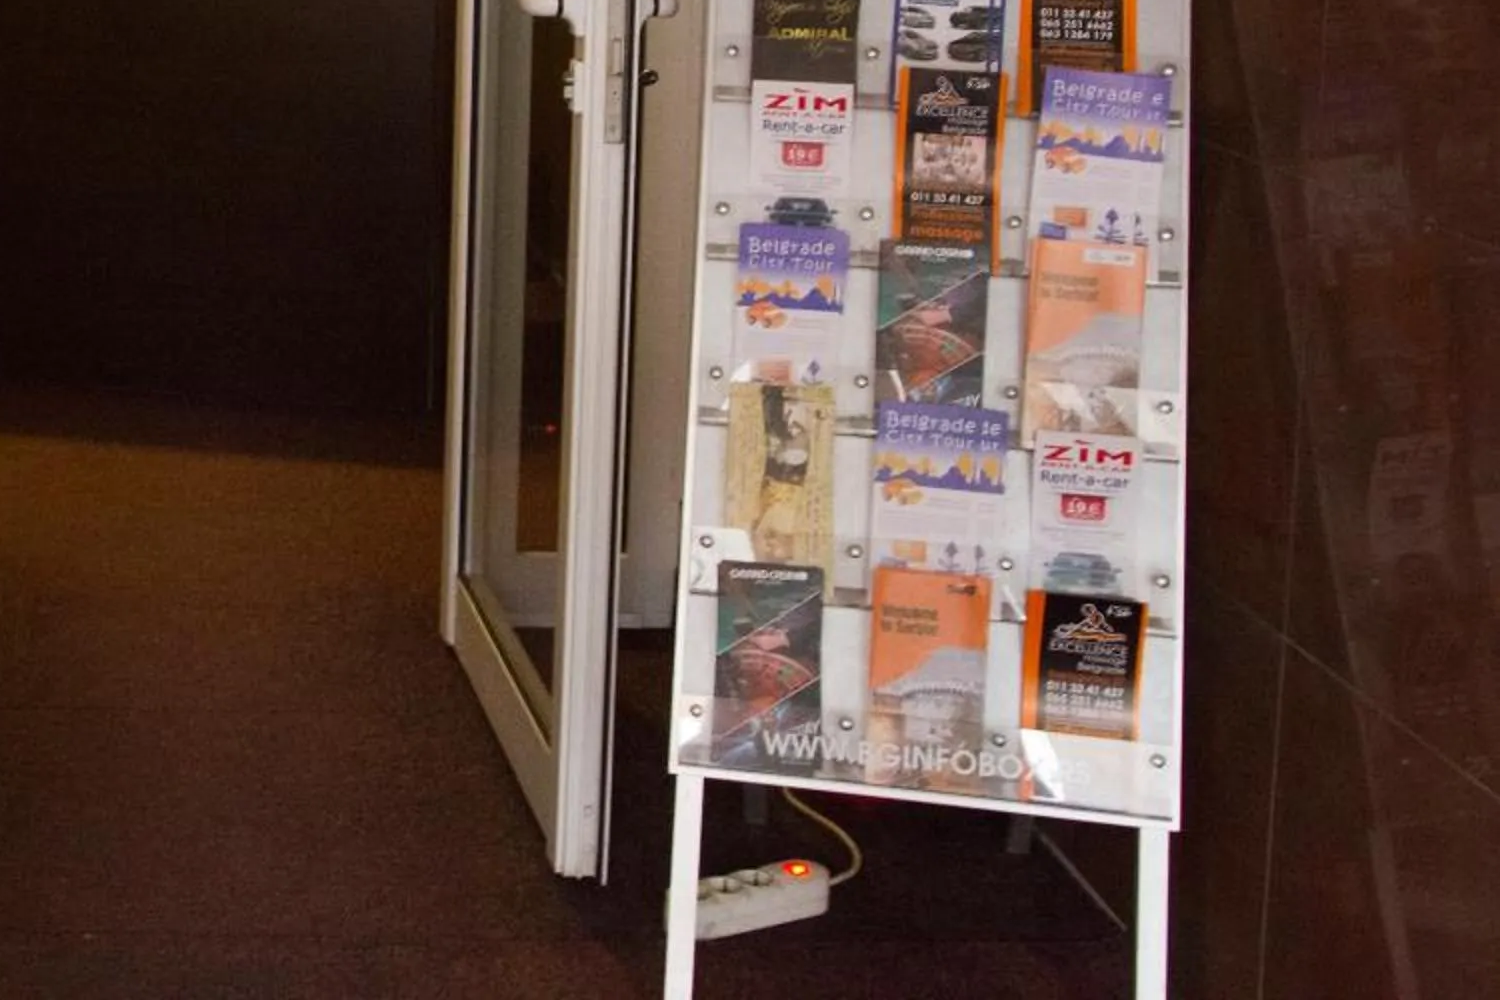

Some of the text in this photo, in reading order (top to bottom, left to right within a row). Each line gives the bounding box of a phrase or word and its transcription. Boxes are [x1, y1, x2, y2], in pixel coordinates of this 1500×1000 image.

[1053, 79, 1143, 103] Belgrade
[763, 119, 846, 135] Rent-a-car
[749, 236, 836, 257] Belgrade
[886, 409, 977, 435] Belgrade
[1041, 470, 1129, 489] Rent-a-car
